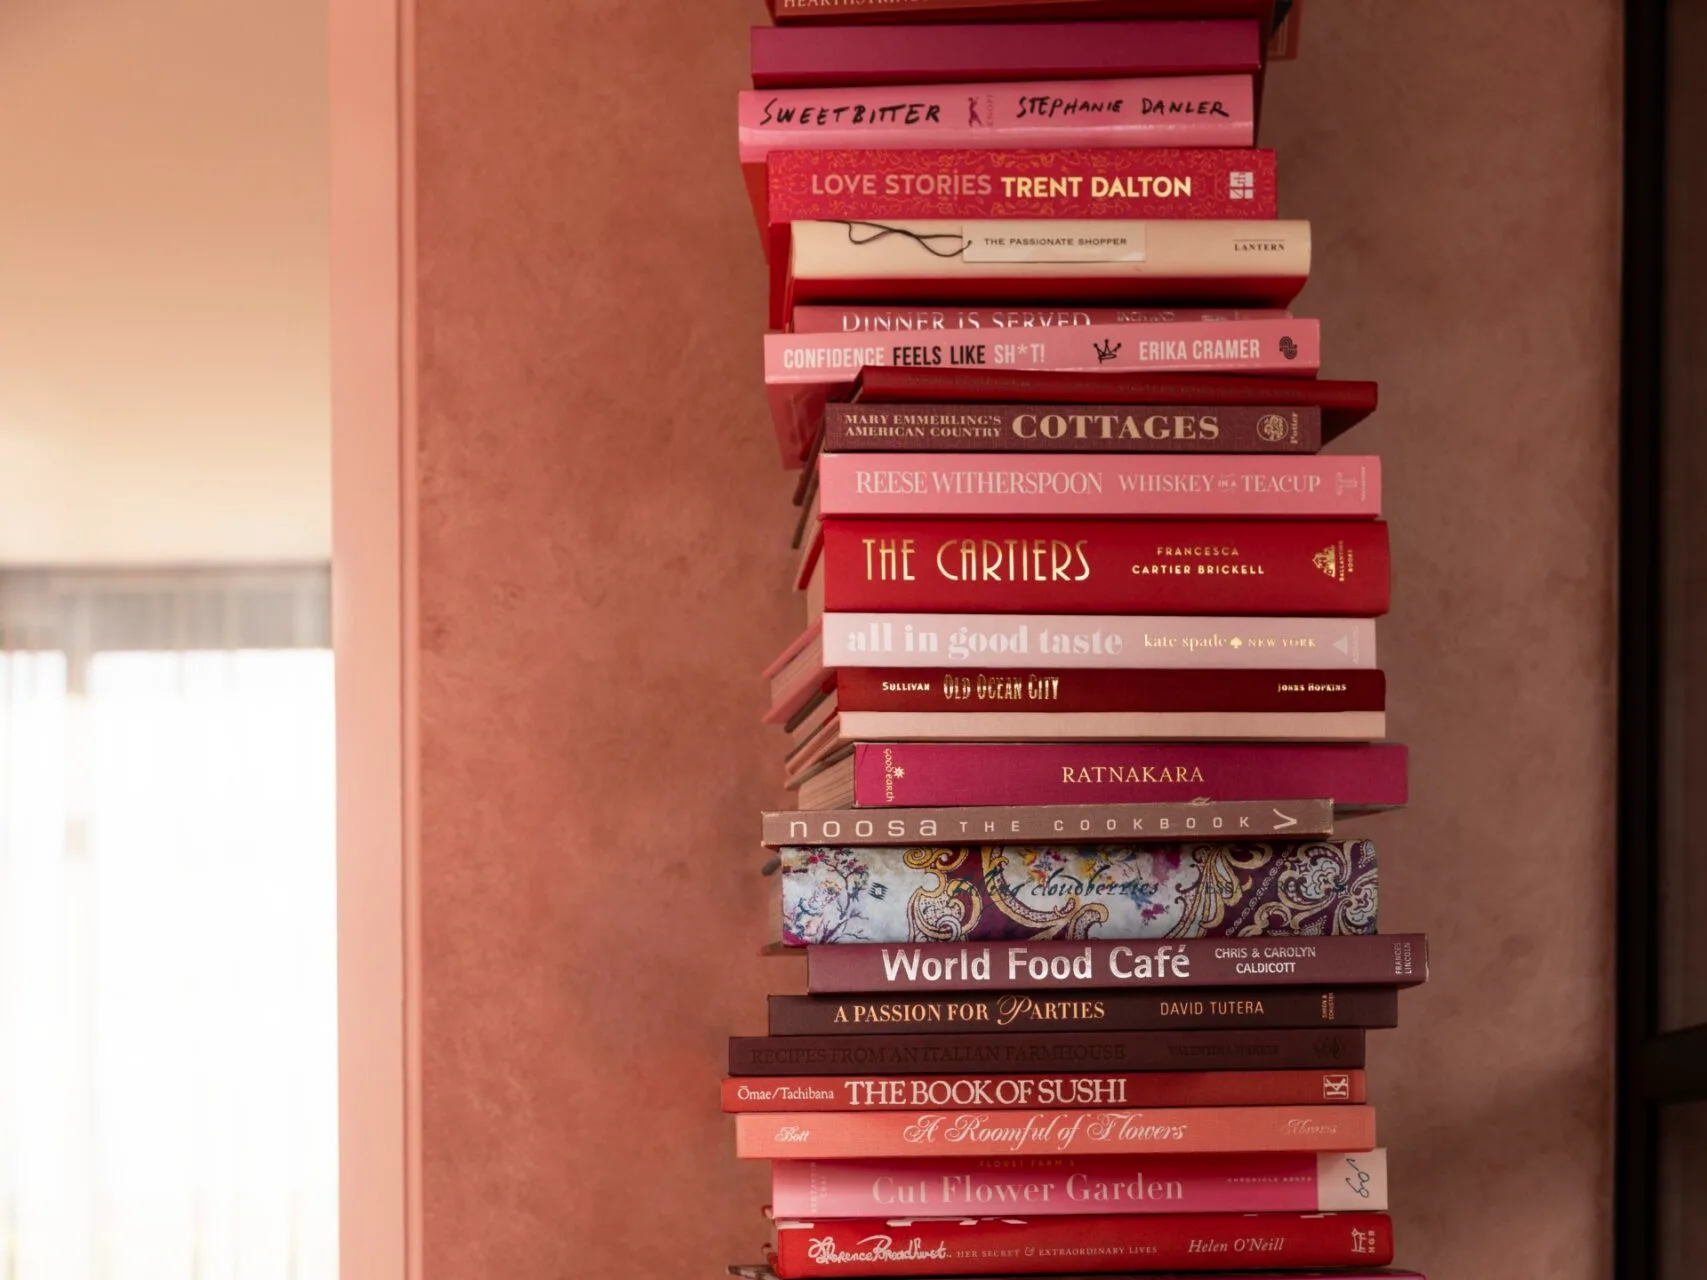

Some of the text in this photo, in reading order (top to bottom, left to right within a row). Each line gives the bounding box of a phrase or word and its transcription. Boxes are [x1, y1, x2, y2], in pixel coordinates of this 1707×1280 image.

[760, 97, 941, 126] SWEETBITTER
[1016, 96, 1230, 118] STEPHANIE DANLER
[812, 173, 992, 195] LOVE STORIES
[1001, 176, 1192, 198] TRENT DALTON
[1010, 238, 1127, 246] PASSIONATE SHOPPER
[841, 312, 945, 332] DINNER
[784, 344, 986, 369] CONFIDENCE FEELS LIKE
[1139, 339, 1260, 361] ERIKA CRAMER
[845, 414, 1002, 426] MARY EMMERLING'S
[1012, 414, 1220, 440] COTTAGES
[845, 427, 1002, 438] AMERICAN COUNTRY
[856, 471, 1104, 495] REESE WITHERSPOON
[1118, 474, 1321, 493] WHISKEY TEACUP
[862, 538, 1090, 581] THE CARTIERS
[1157, 546, 1240, 557] FRANCESCA
[1132, 564, 1265, 575] CARTIER BRICKELL
[846, 622, 1123, 660] all in good taste
[1143, 633, 1227, 651] kate spade
[976, 673, 1022, 700] OCEAN
[1062, 766, 1205, 783] RATNAKARA
[789, 816, 1250, 838] noosa THE COOKBOOK
[882, 943, 1191, 982] World Food Café
[1215, 946, 1316, 959] CHRIS CAROLYN
[1236, 962, 1297, 974] CALDICOTT
[833, 995, 1106, 1026] A PASSION FOR PARTIES
[1160, 1000, 1265, 1016] DAVID TUTERA
[831, 1047, 885, 1064] FROM
[890, 1047, 921, 1062] AN
[845, 1078, 1128, 1106] THE BOOK OF SUSHI
[944, 1112, 1189, 1152] Roomful Flowers
[872, 1171, 1184, 1205] Cut Flower Garden
[1188, 1237, 1285, 1254] Helen O'Neill
